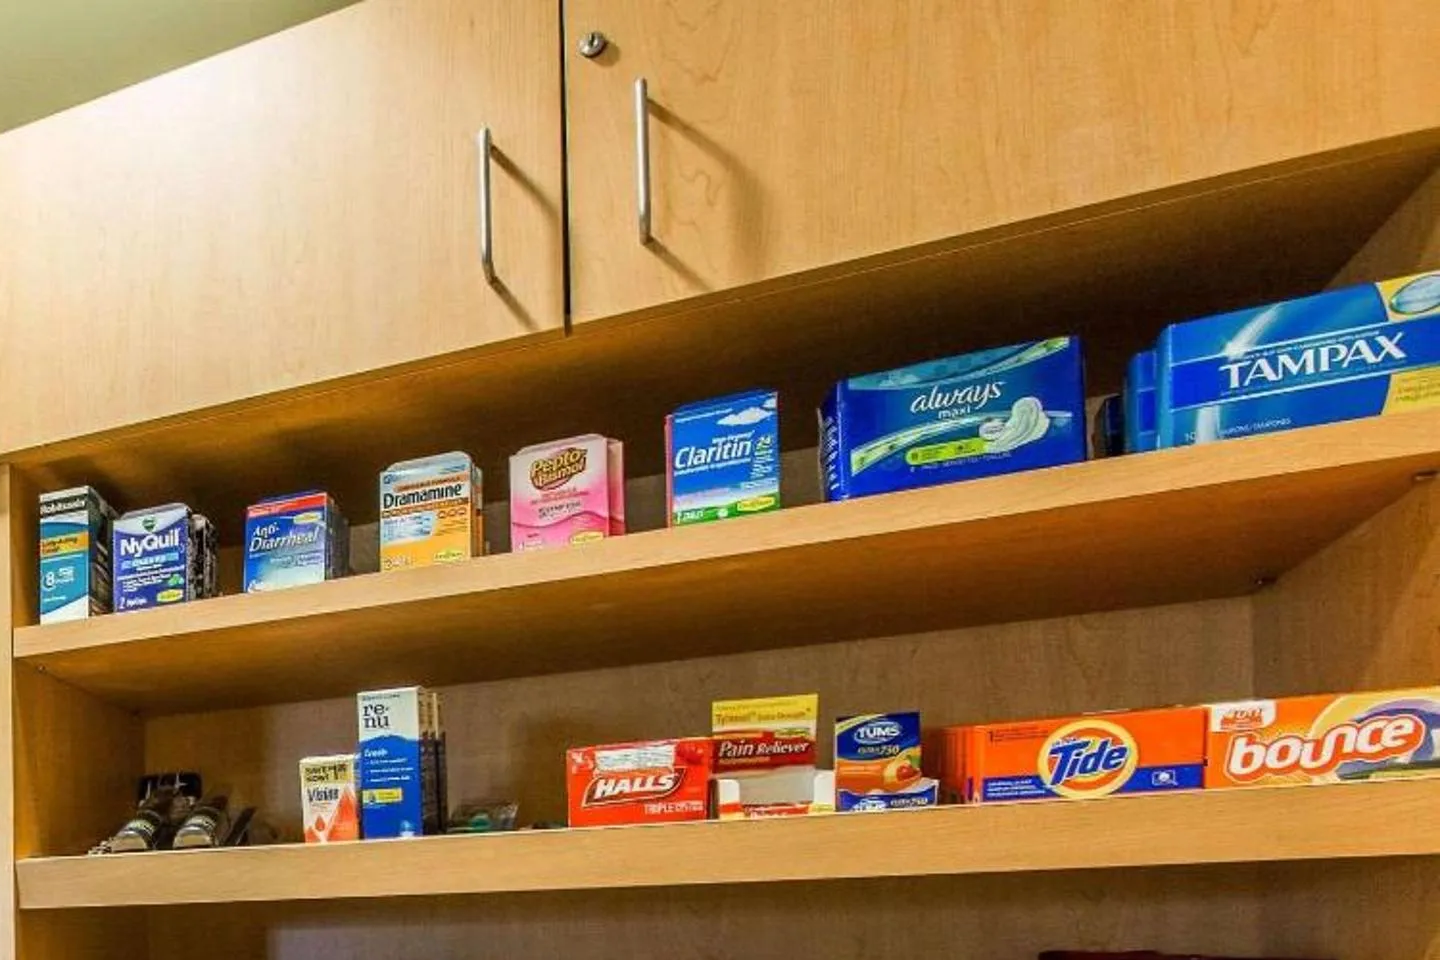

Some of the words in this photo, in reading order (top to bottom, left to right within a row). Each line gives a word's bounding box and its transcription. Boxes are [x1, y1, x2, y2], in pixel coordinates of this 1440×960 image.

[1219, 332, 1408, 388] TAMPAX
[911, 382, 1007, 415] always
[938, 407, 971, 420] maxi
[674, 440, 752, 470] Claritin
[383, 483, 463, 509] Dramamine
[120, 527, 181, 558] NyQuil
[718, 738, 755, 757] Pain
[755, 740, 810, 755] Reliever
[858, 726, 901, 739] TUMS
[1228, 717, 1416, 776] bounce
[1048, 738, 1128, 787] Tide
[593, 774, 676, 801] HALLS
